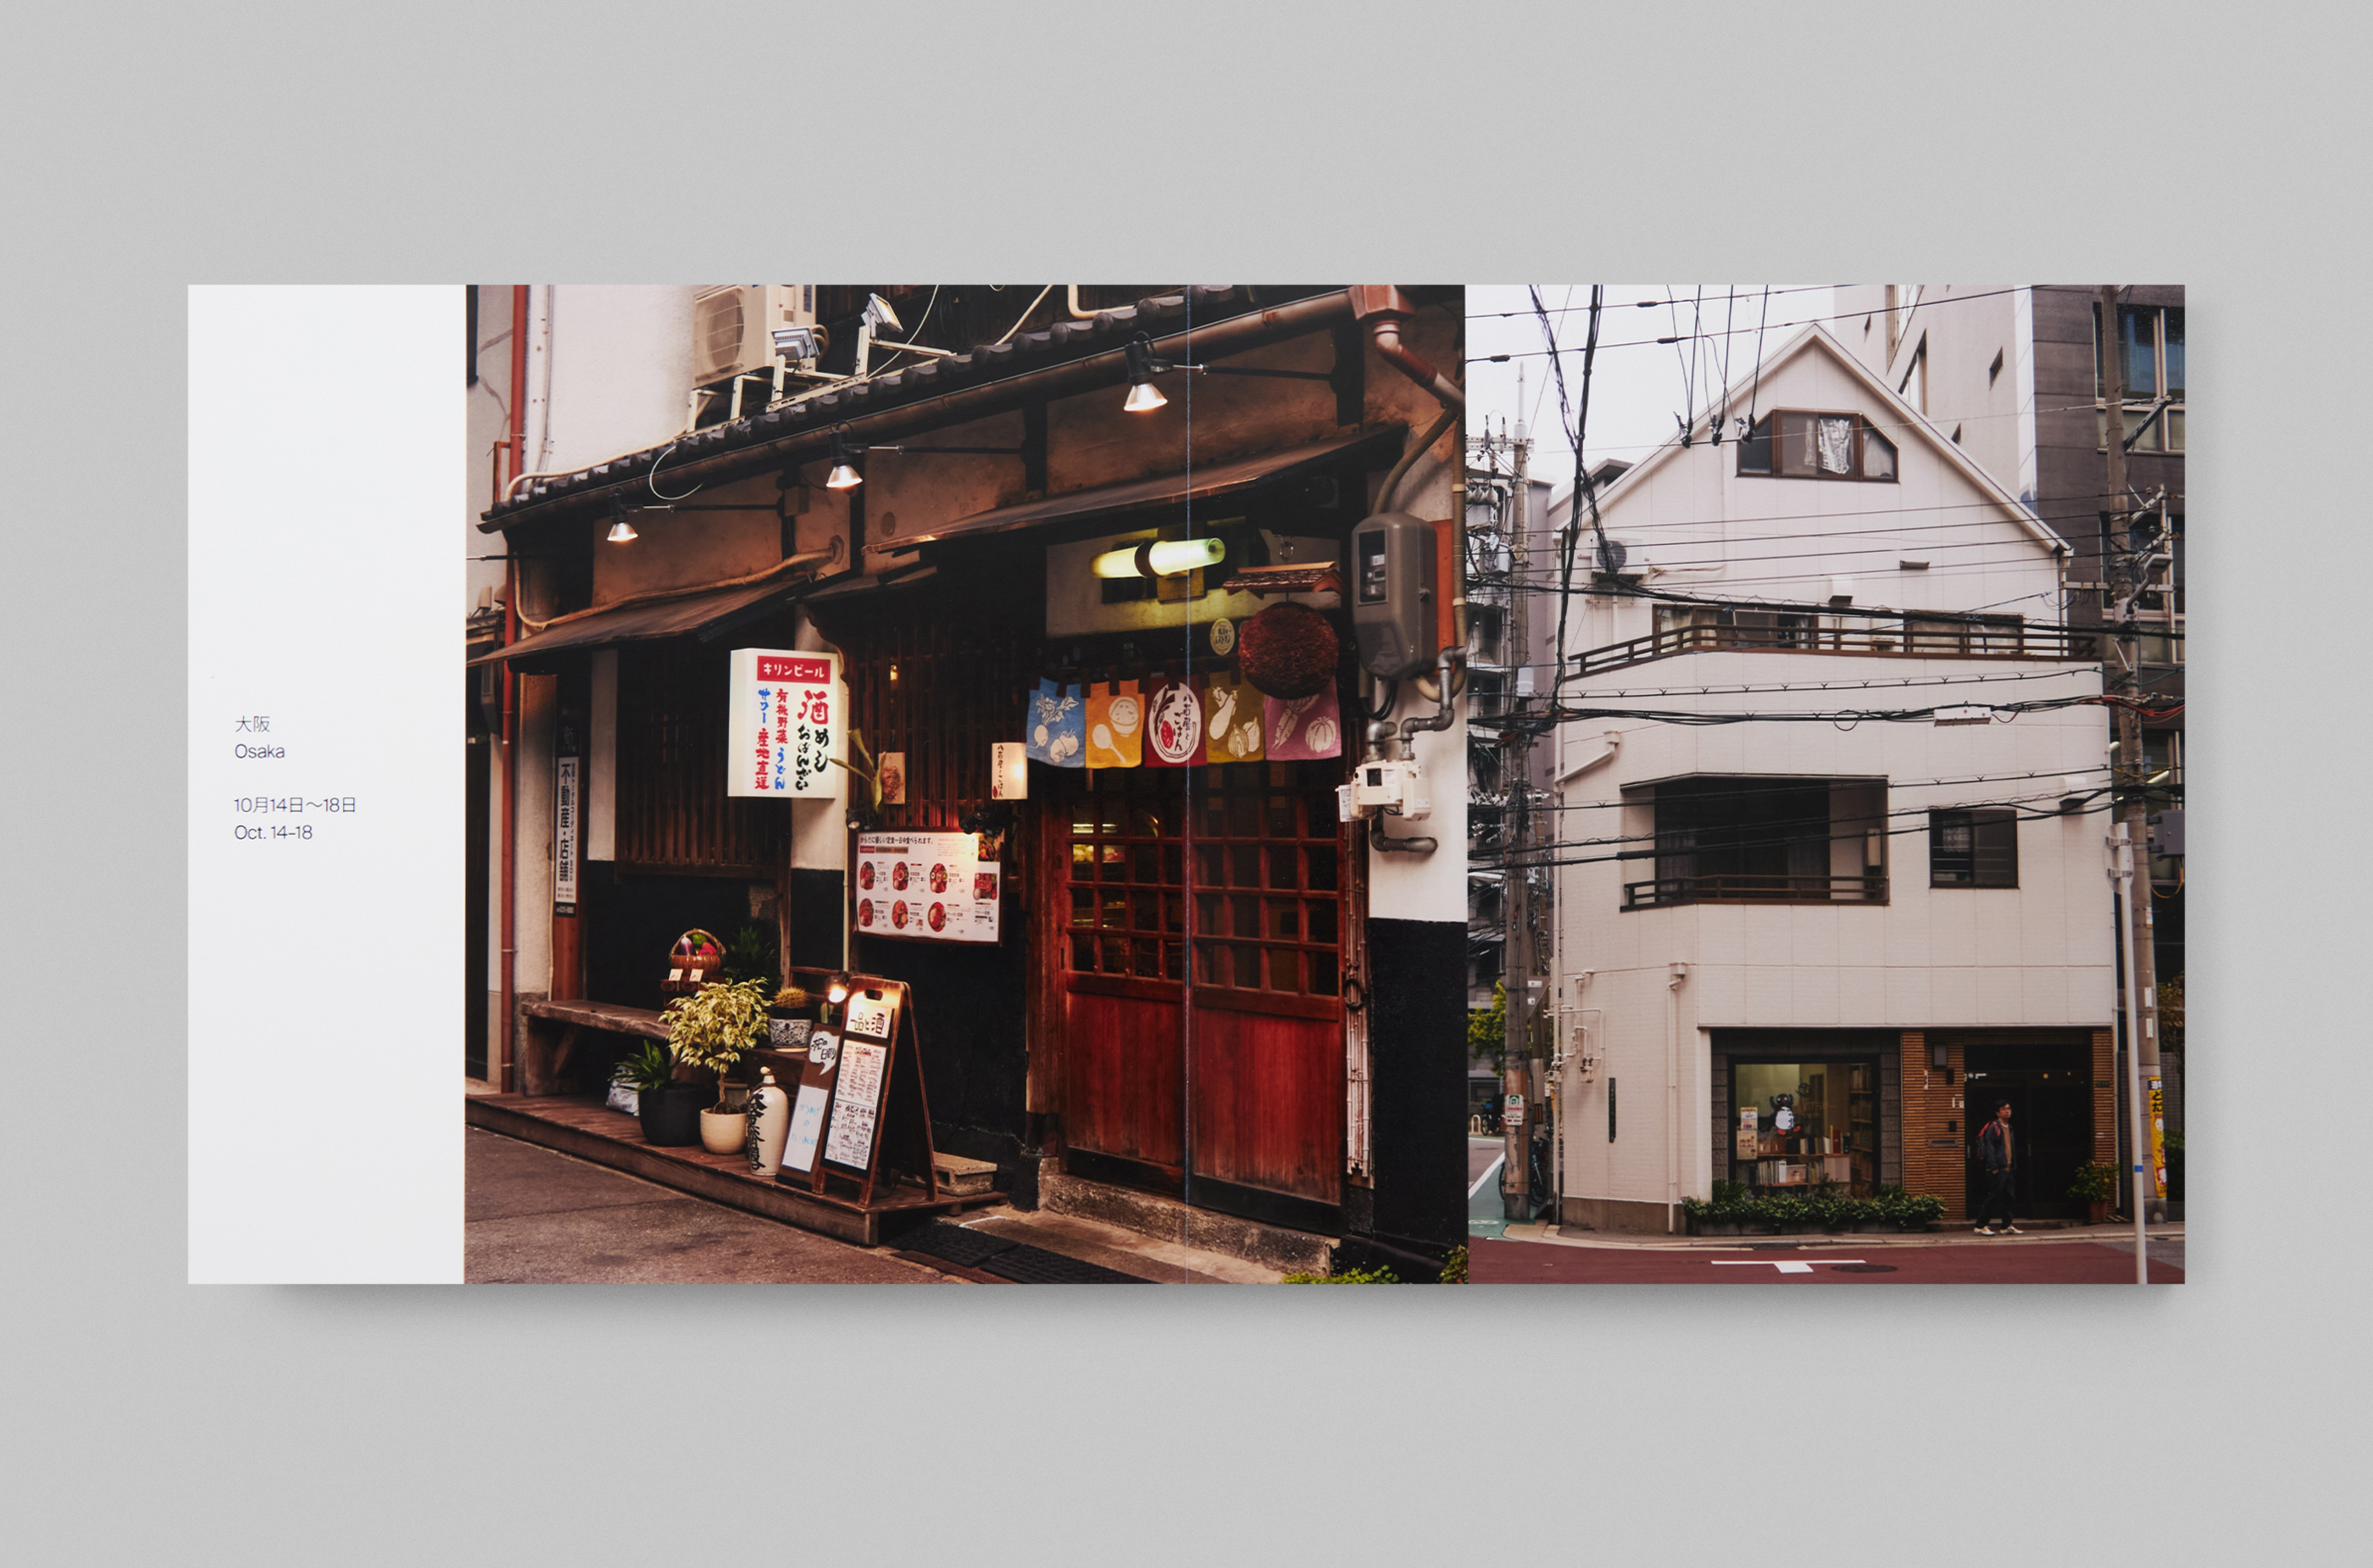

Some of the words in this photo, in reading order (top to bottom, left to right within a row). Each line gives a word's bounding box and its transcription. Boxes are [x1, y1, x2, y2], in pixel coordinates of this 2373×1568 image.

[764, 663, 825, 679] キリンビール
[235, 715, 270, 733] 大阪
[775, 688, 789, 744] 有機野菜
[797, 689, 829, 725] 酒
[235, 743, 286, 759] Osaka
[814, 727, 830, 773] めし
[1173, 711, 1183, 752] ごはん
[754, 727, 770, 790] 産地直送
[775, 747, 786, 790] うどん
[795, 723, 813, 791] おばんざい
[235, 825, 267, 840] Oct.
